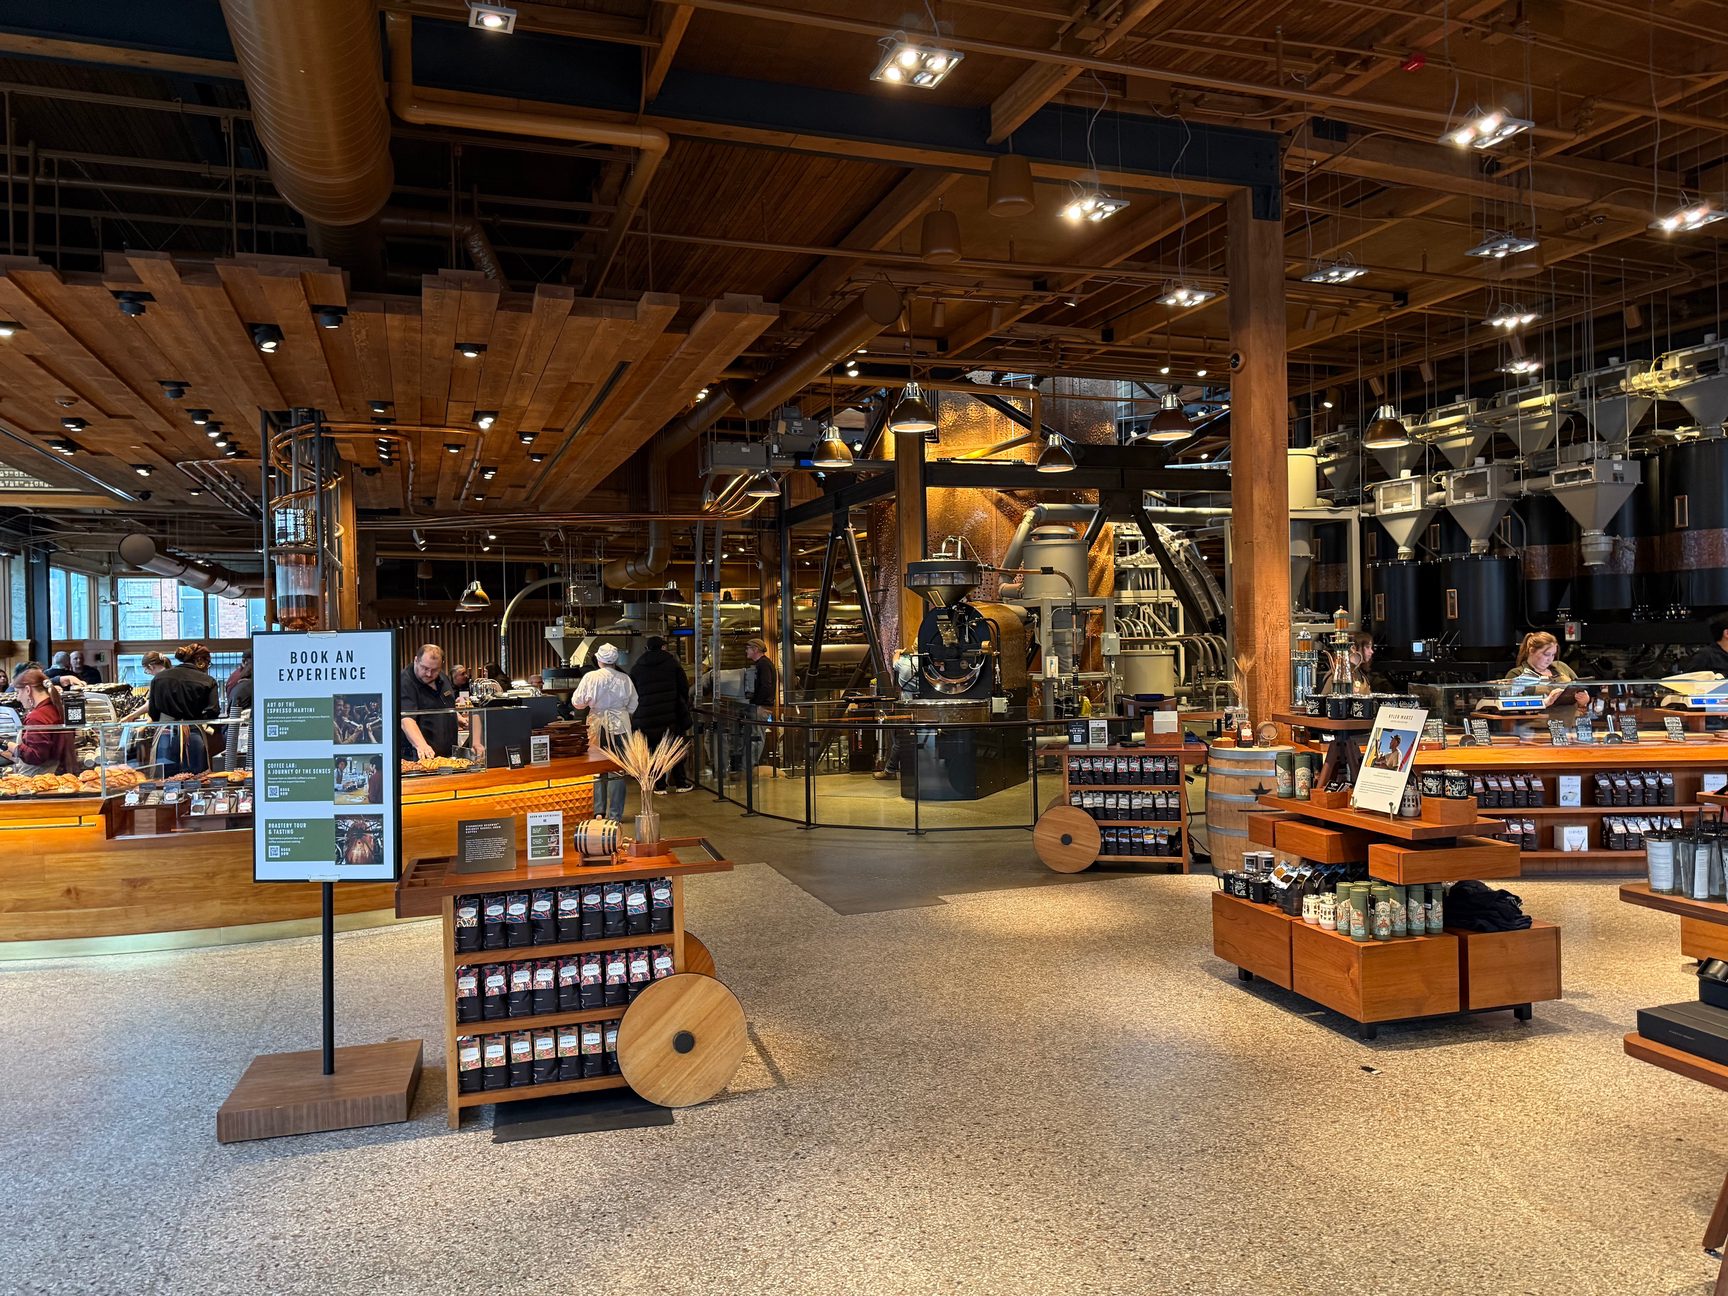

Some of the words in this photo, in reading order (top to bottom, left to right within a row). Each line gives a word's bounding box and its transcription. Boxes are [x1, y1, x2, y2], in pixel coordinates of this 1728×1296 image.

[290, 651, 328, 664] BOOK
[336, 650, 354, 663] AN
[279, 667, 366, 681] EXPERIENCE
